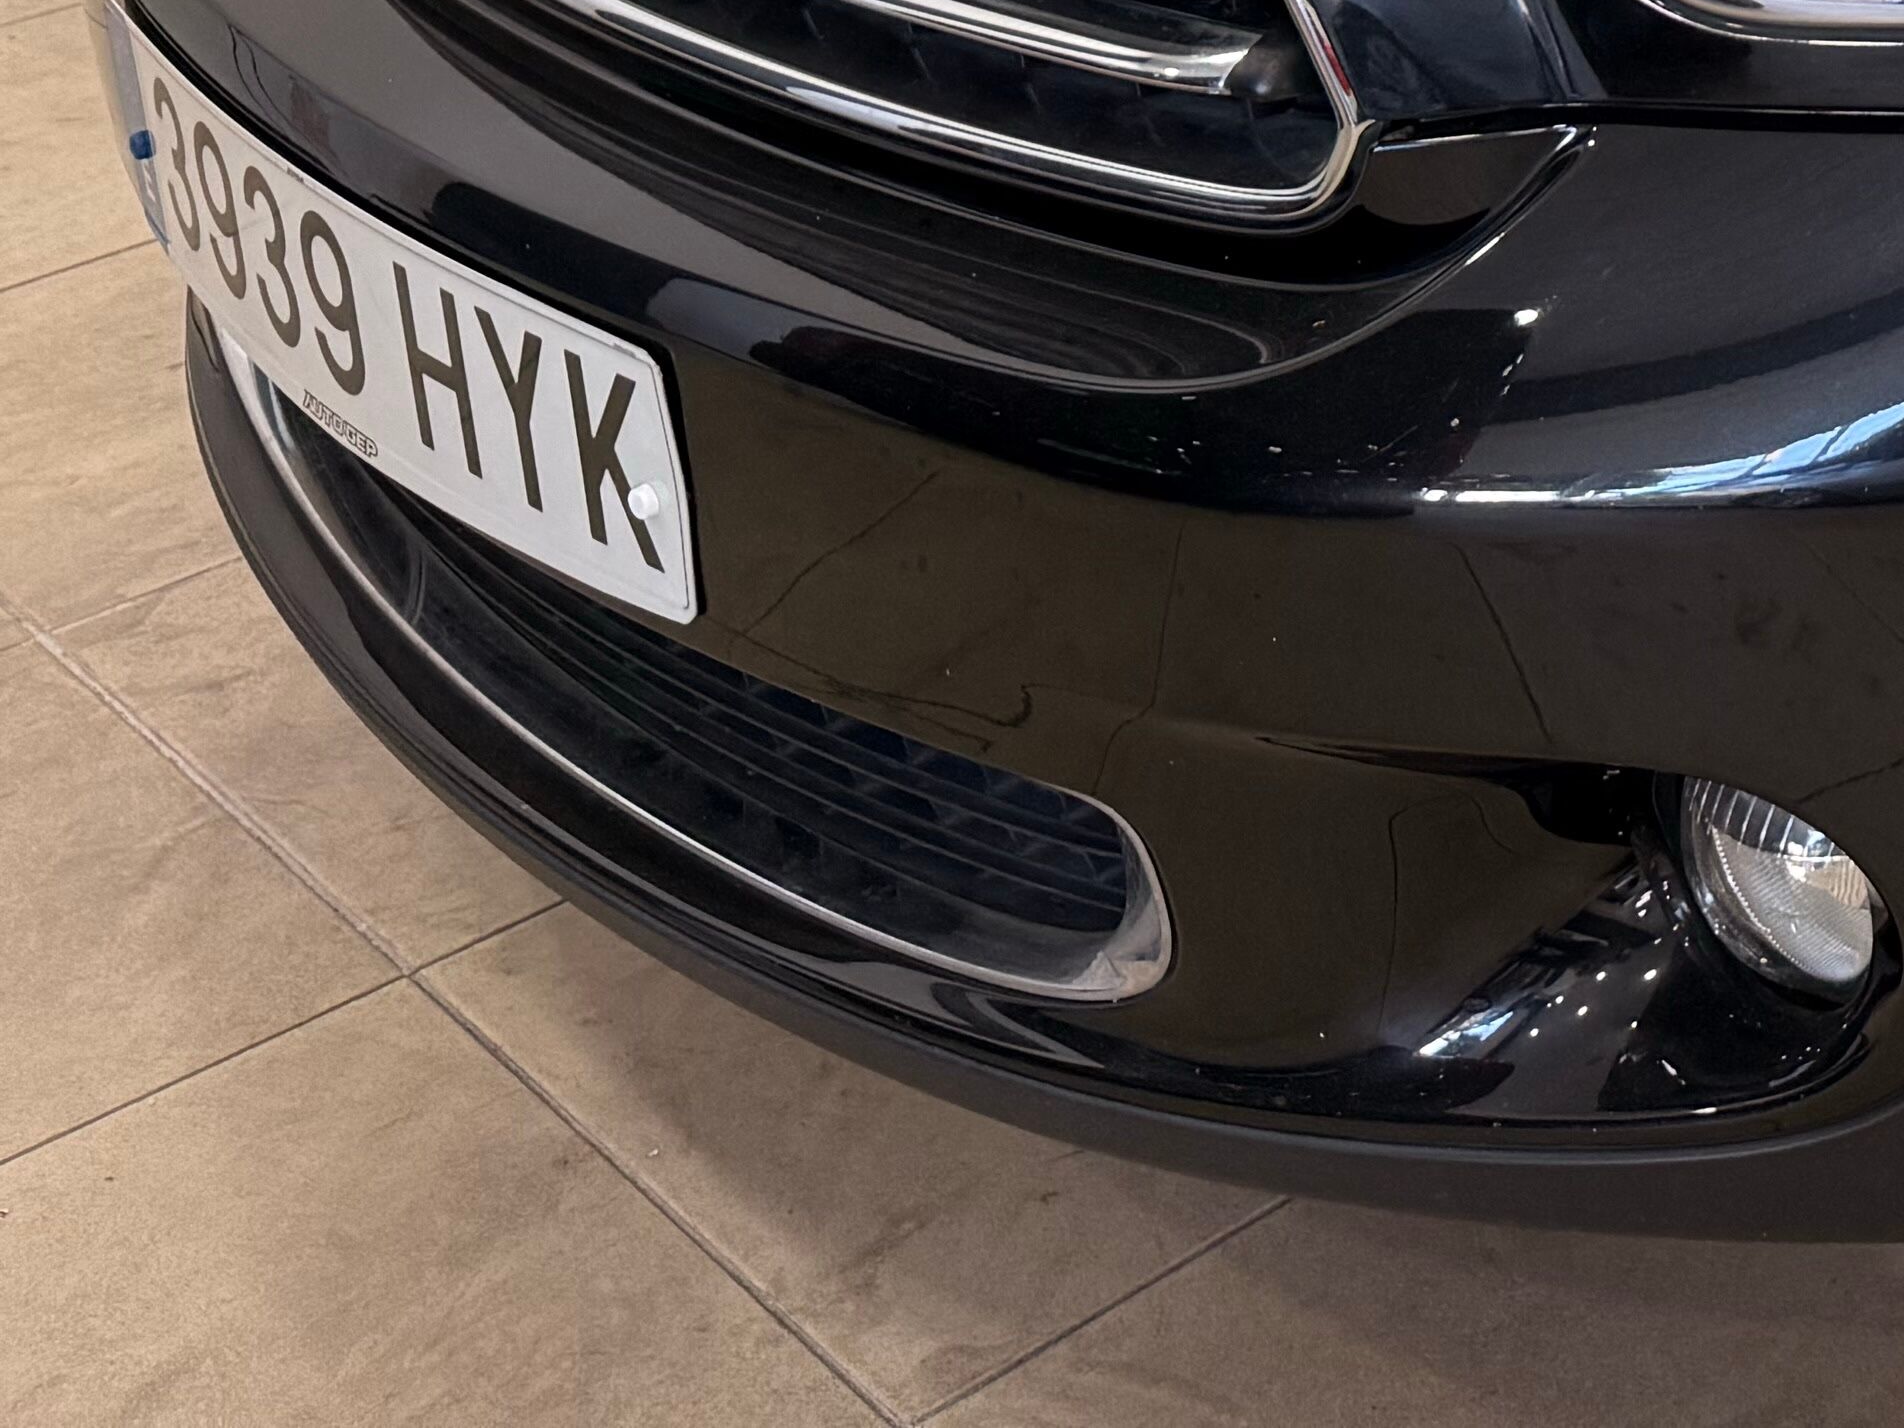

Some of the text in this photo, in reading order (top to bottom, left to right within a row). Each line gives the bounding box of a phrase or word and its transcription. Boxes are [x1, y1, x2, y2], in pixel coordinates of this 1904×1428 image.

[153, 76, 666, 574] 3939 HYK
[342, 419, 379, 458] GEP
